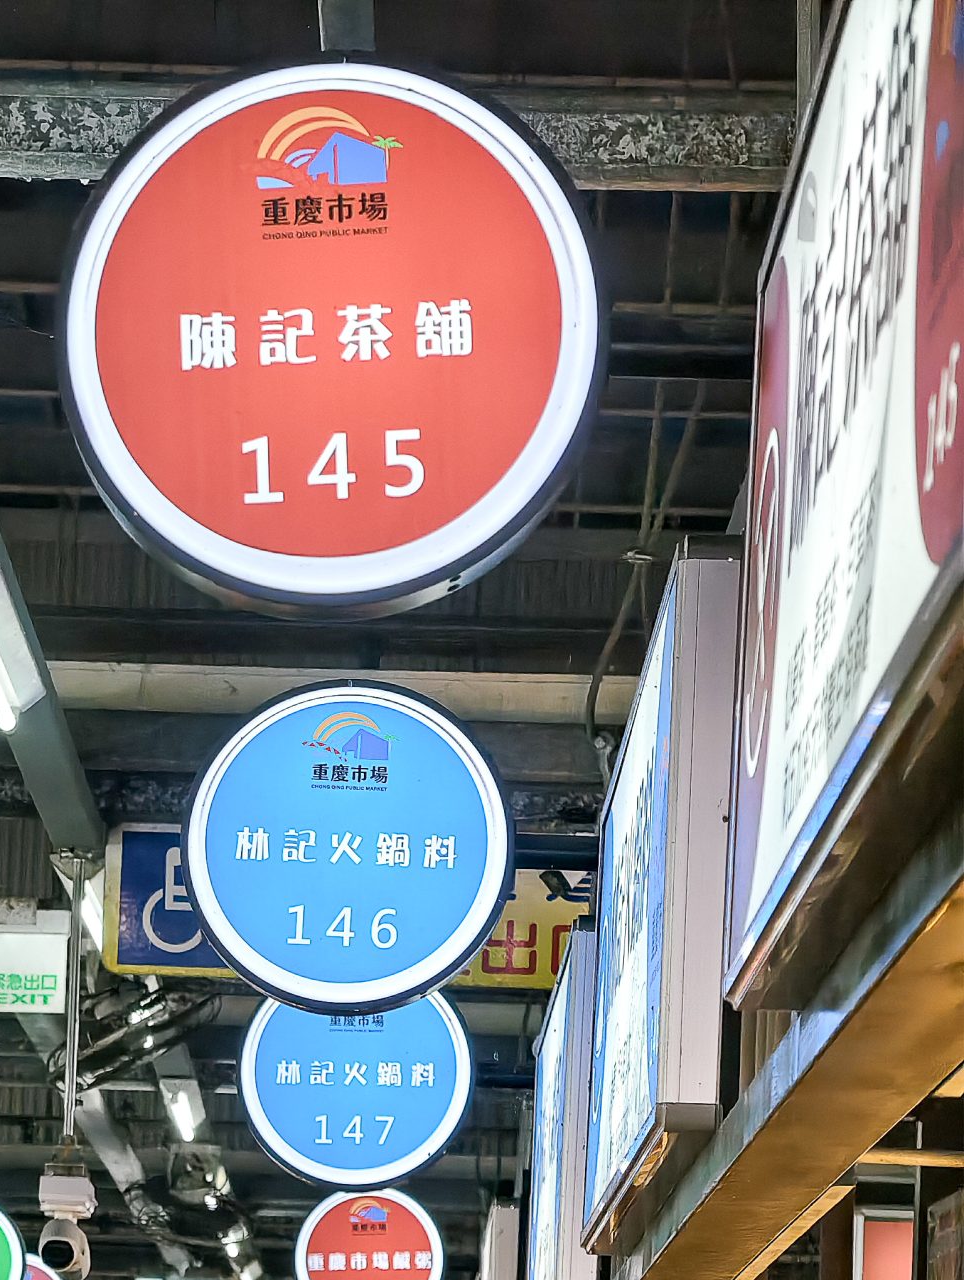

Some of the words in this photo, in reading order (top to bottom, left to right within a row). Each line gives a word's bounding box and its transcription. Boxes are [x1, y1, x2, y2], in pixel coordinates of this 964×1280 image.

[261, 192, 389, 226] 重慶市場
[262, 232, 294, 241] CHONG
[296, 230, 318, 239] QING
[319, 228, 351, 238] PUBLIC
[352, 226, 389, 236] MARKET
[179, 298, 474, 371] 陳記茶舖
[923, 341, 961, 493] 145
[241, 428, 426, 505] 145
[311, 763, 389, 784] 重慶市場
[235, 826, 458, 869] 林記火鍋料
[286, 904, 400, 949] 146
[276, 1060, 436, 1087] 林記火鍋料
[314, 1114, 396, 1145] 147
